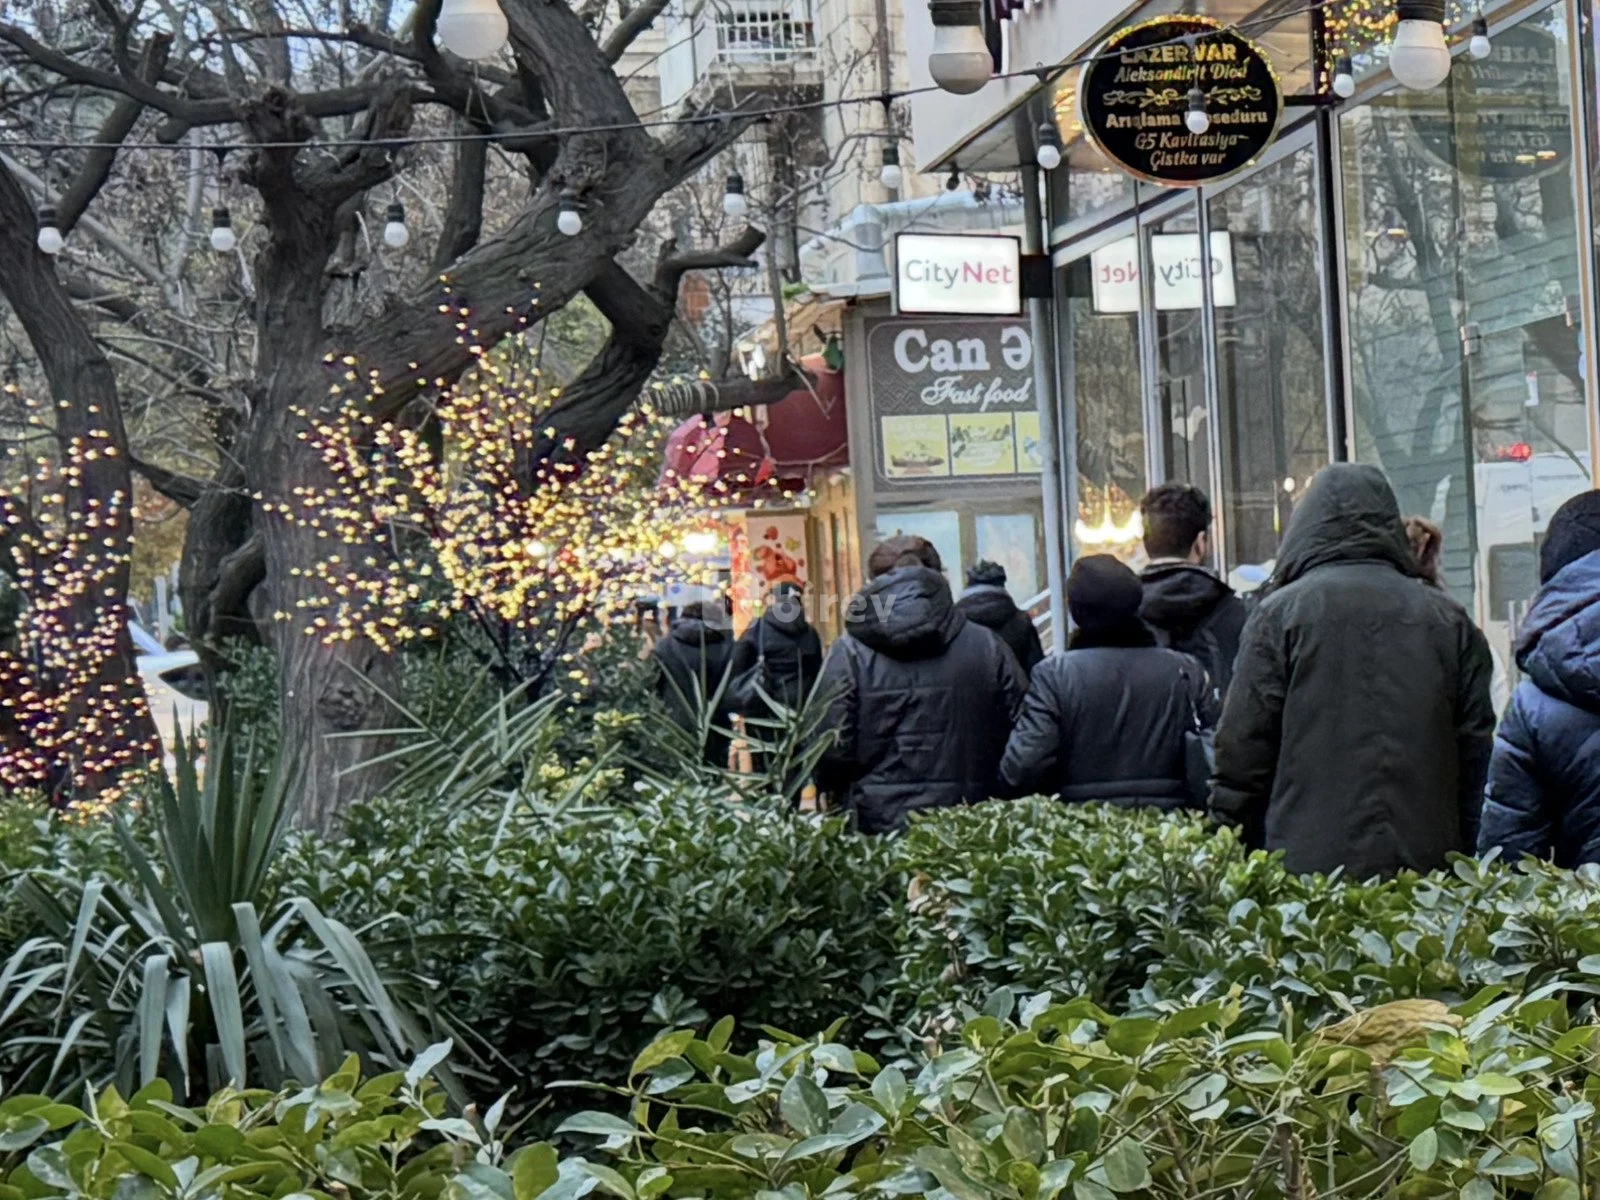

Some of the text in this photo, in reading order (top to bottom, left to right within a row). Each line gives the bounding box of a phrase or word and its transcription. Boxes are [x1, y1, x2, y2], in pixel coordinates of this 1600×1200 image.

[1120, 44, 1236, 64] LAZER VAR
[1135, 133, 1155, 150] G5
[1150, 152, 1226, 171] Çistka var
[905, 259, 1013, 289] CityNet
[894, 328, 989, 373] Can
[921, 376, 1031, 411] Fast food
